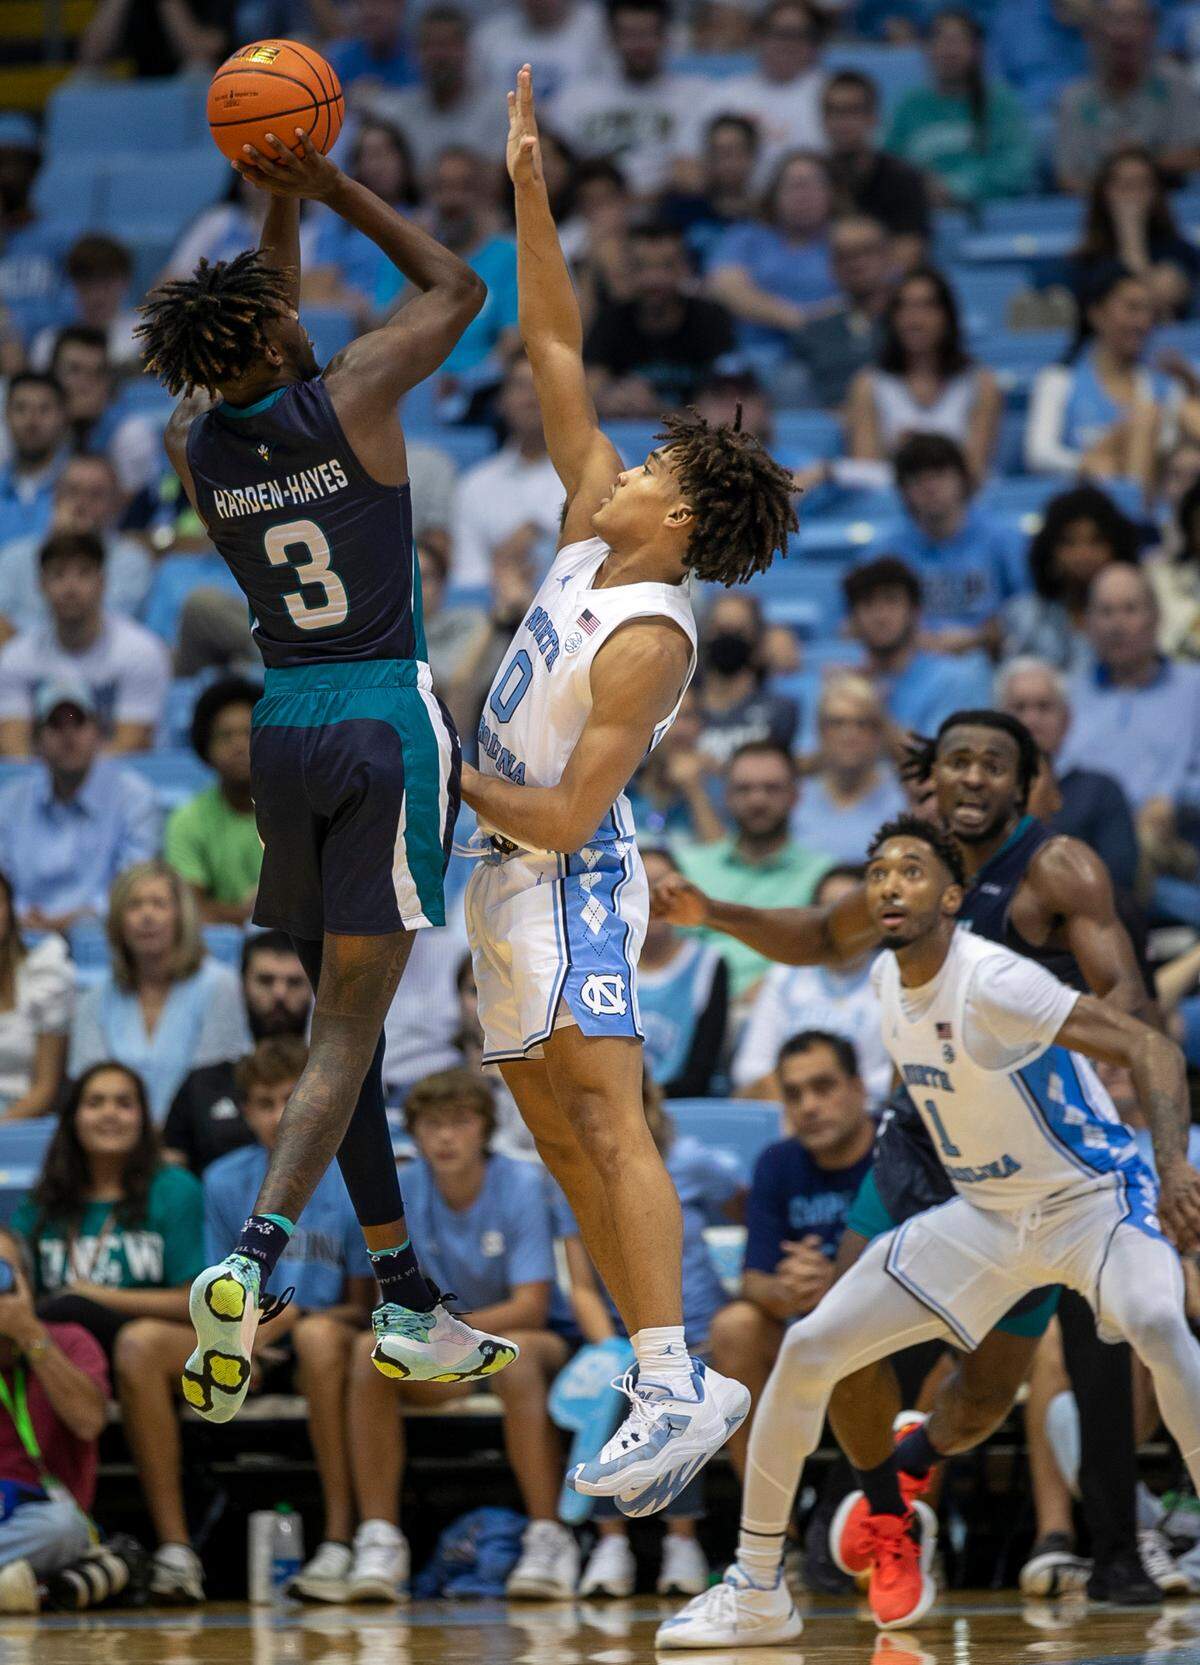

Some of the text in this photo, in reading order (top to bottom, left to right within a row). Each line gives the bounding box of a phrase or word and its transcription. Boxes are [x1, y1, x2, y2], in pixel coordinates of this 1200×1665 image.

[214, 459, 349, 519] HARDEN-HAYES
[264, 519, 348, 630] 3
[490, 649, 533, 723] 0
[925, 1099, 961, 1157] 1
